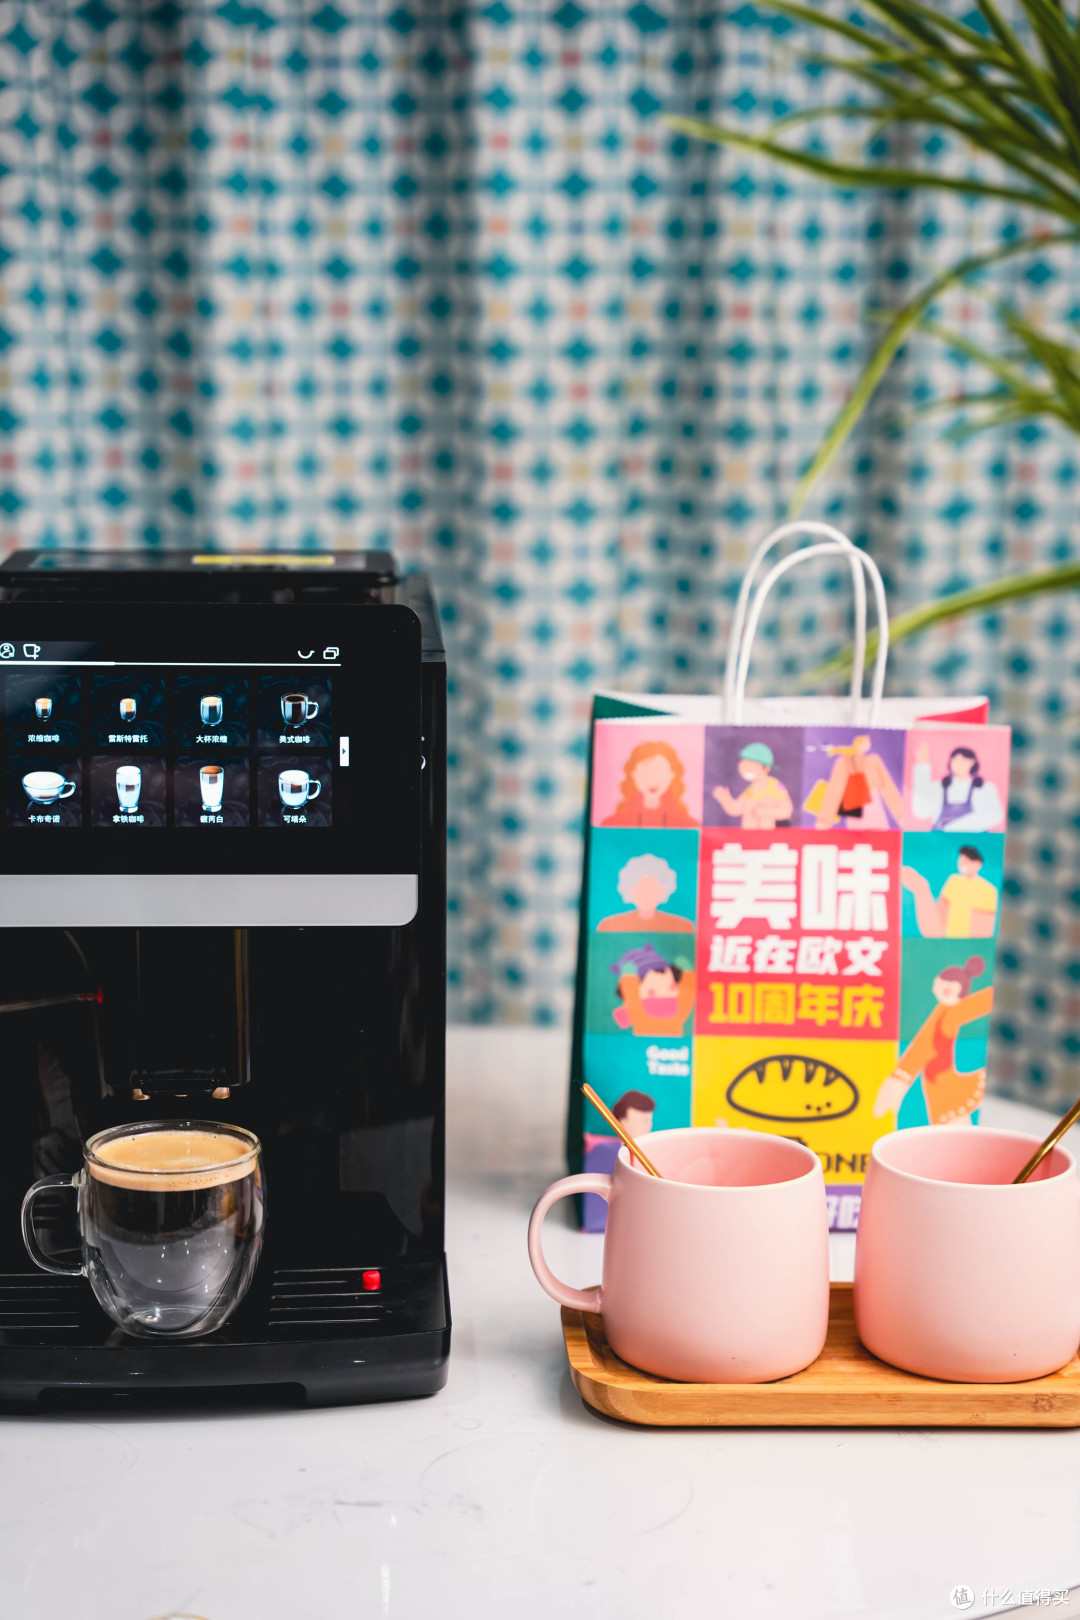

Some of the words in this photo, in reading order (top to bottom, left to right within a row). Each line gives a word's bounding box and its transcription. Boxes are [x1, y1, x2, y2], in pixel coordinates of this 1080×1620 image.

[27, 734, 60, 743] 浓缩咖啡
[195, 735, 228, 744] 大杯浓缩
[279, 735, 311, 744] 美式咖啡
[28, 815, 61, 823] 卡布奇诺
[112, 815, 145, 823] 拿铁咖啡
[710, 842, 890, 931] 美味
[707, 934, 889, 977] 近在欧文
[708, 982, 885, 1028] 10周年庆
[645, 1044, 690, 1061] Good
[645, 1060, 690, 1077] Taste
